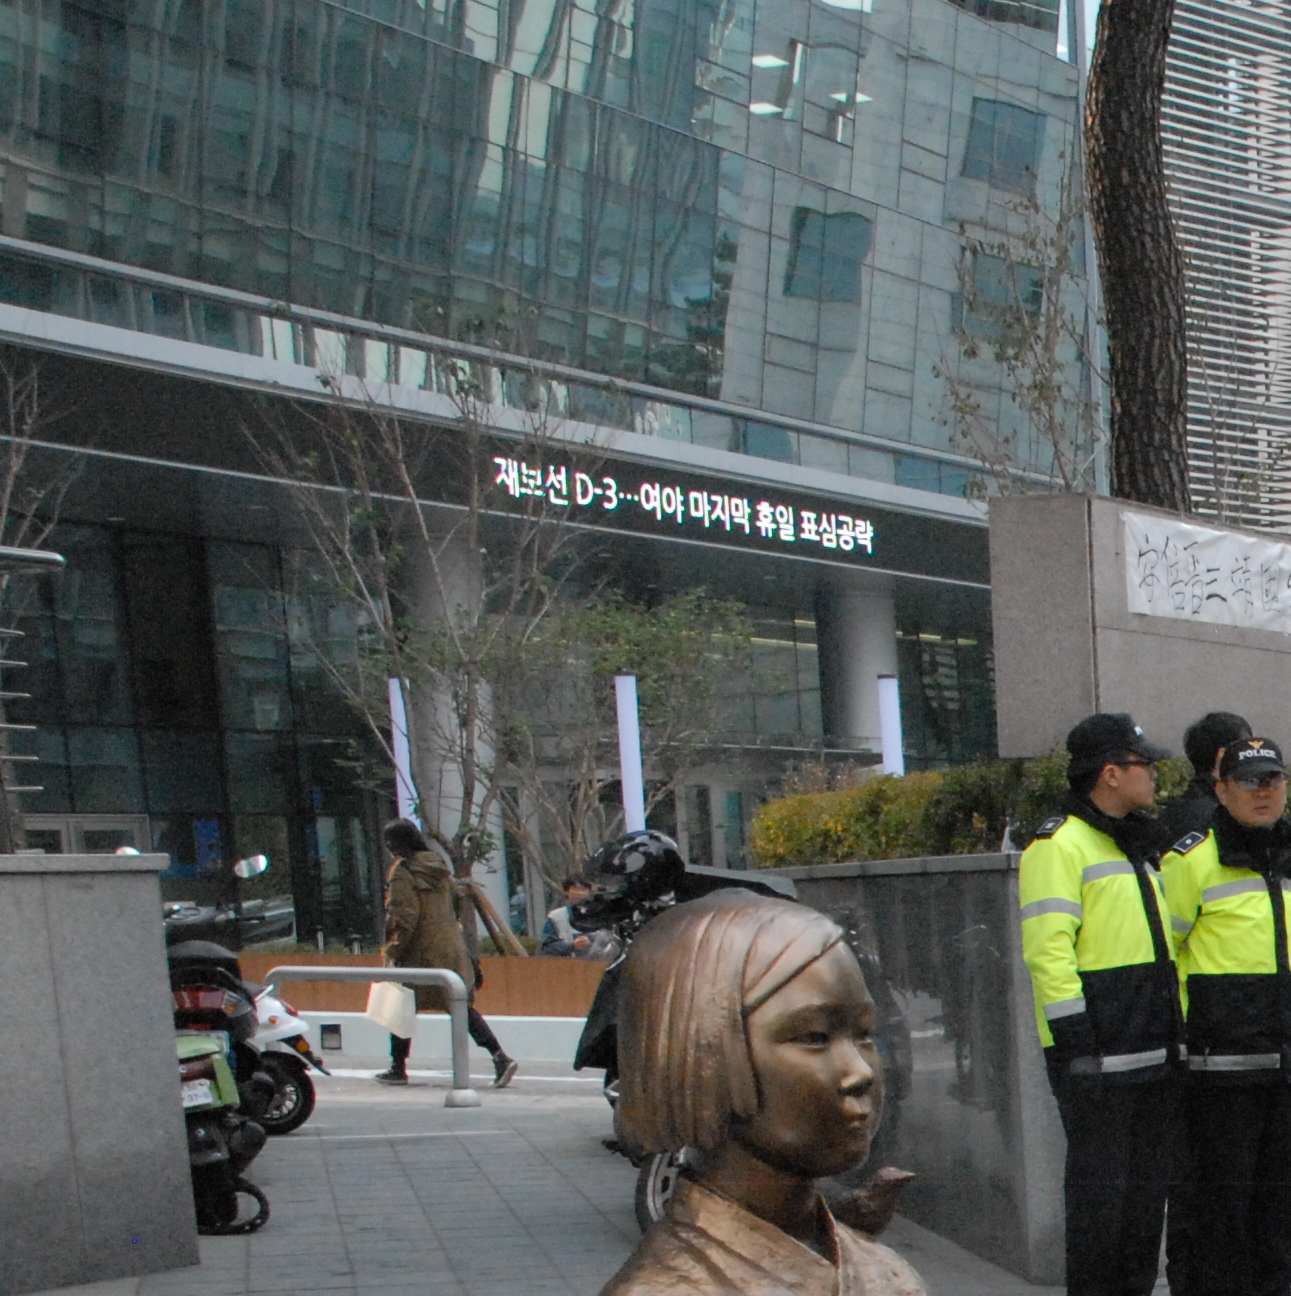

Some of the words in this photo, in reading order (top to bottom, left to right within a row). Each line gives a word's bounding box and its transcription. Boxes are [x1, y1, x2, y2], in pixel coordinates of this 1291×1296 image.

[493, 456, 568, 507] 재보선
[689, 490, 751, 535] 마지막
[755, 499, 795, 543] 휴일
[799, 510, 874, 555] 표심공략
[1238, 749, 1278, 761] POLICE
